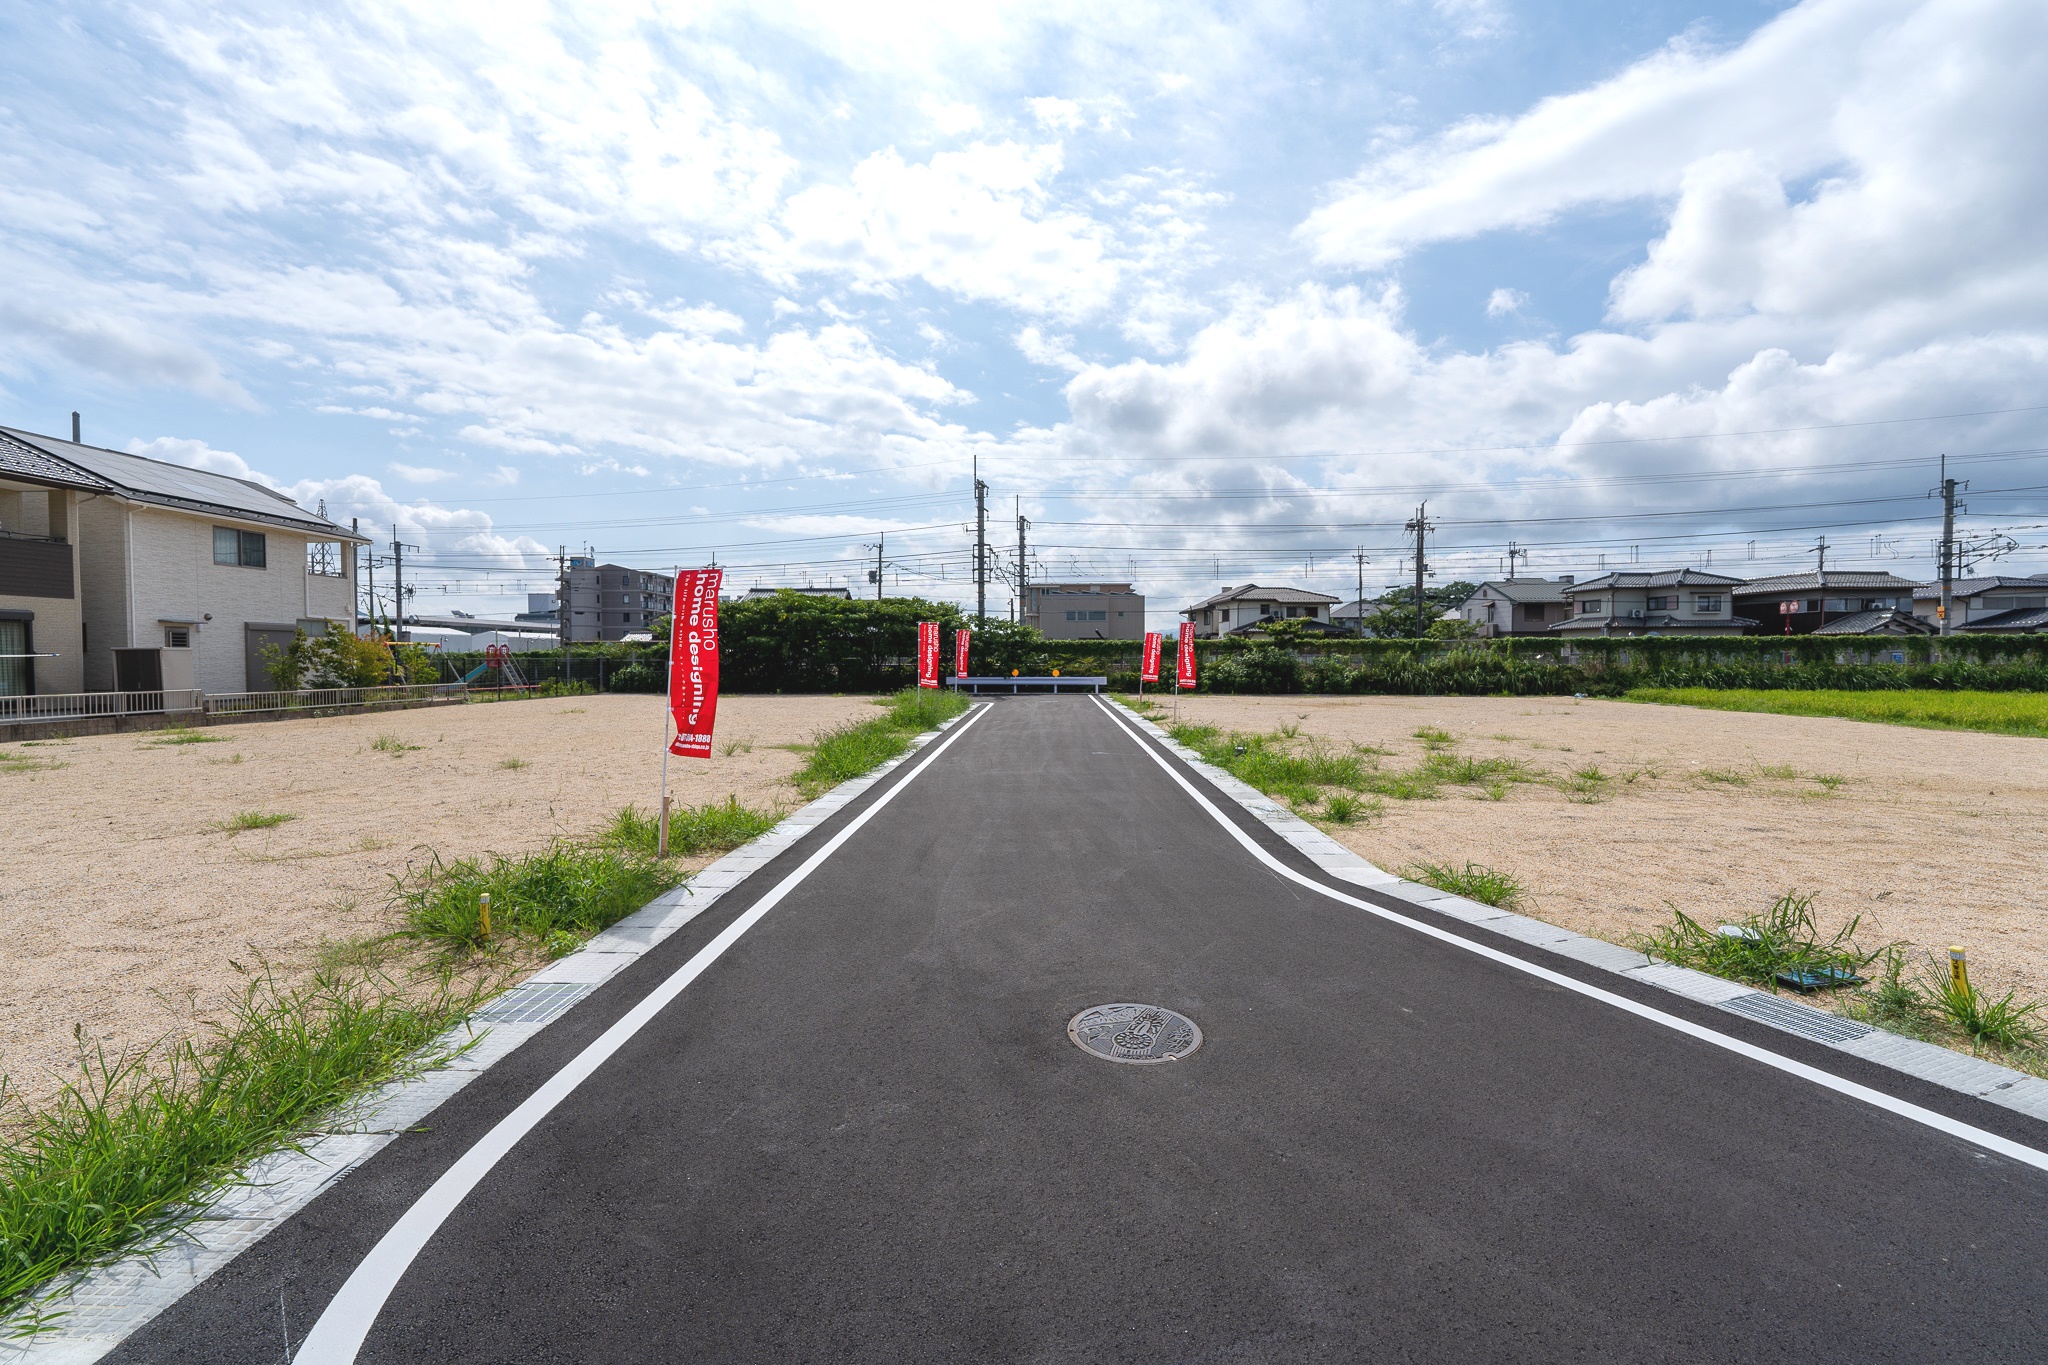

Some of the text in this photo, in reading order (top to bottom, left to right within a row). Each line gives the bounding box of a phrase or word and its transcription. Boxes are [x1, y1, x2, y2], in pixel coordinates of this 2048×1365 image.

[690, 573, 709, 627] home
[702, 573, 719, 651] marusho
[688, 631, 705, 725] designing
[1184, 644, 1192, 676] designing
